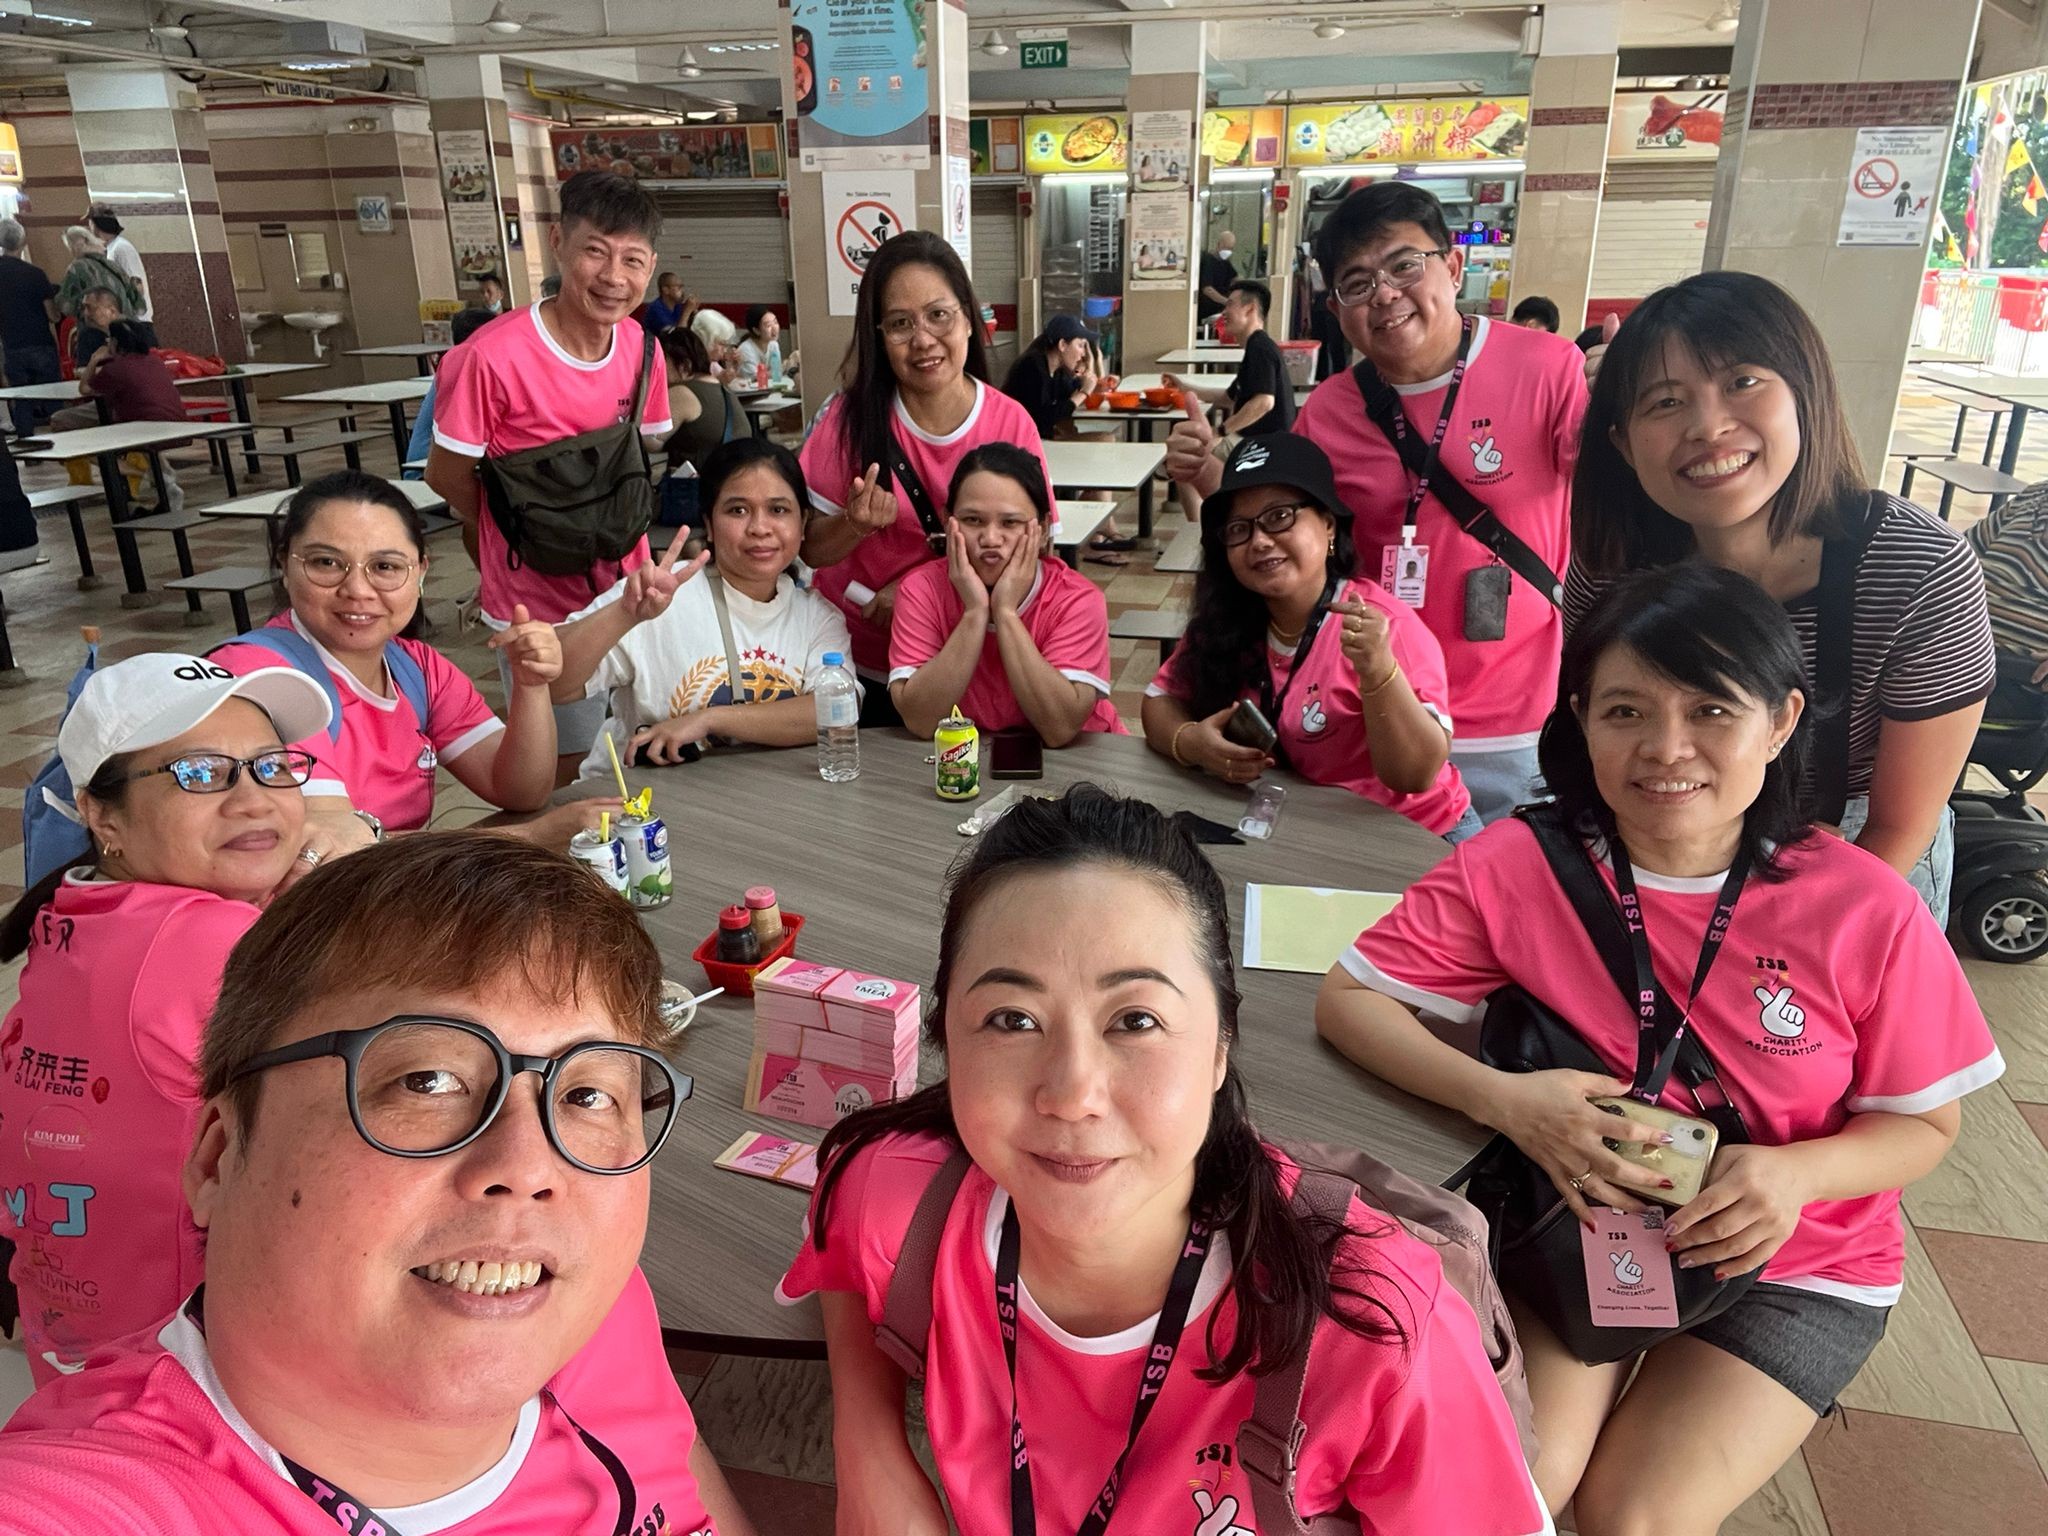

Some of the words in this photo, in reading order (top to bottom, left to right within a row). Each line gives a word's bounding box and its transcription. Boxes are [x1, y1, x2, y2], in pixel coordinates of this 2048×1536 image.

[830, 9, 839, 17] to
[841, 7, 865, 17] avoid
[1025, 46, 1055, 65] EXIT
[870, 191, 891, 199] Littering
[1451, 360, 1466, 385] TSB
[1432, 418, 1448, 446] TSB
[1471, 418, 1492, 429] TSB
[1384, 549, 1396, 594] TSB
[174, 660, 234, 681] alo
[942, 742, 971, 762] Sagiko
[1621, 893, 1643, 934] TSB
[1699, 903, 1736, 943] TSB
[1755, 956, 1788, 971] TSB
[1640, 989, 1655, 1031] TSB
[1745, 1040, 1823, 1056] ASSOCIATION
[1763, 1036, 1808, 1047] CHARITY
[17, 1046, 90, 1084] 齐来丰
[44, 1081, 84, 1098] FENG
[33, 1129, 54, 1141] KIM
[56, 1133, 80, 1144] POH
[1608, 1232, 1628, 1240] TSB
[40, 1270, 99, 1298] LIVING
[1607, 1287, 1656, 1297] ASSOCIATION
[1616, 1283, 1644, 1291] CHARITY
[998, 1282, 1015, 1342] TSB
[1141, 1343, 1174, 1400] TSB
[1013, 1416, 1028, 1471] SB
